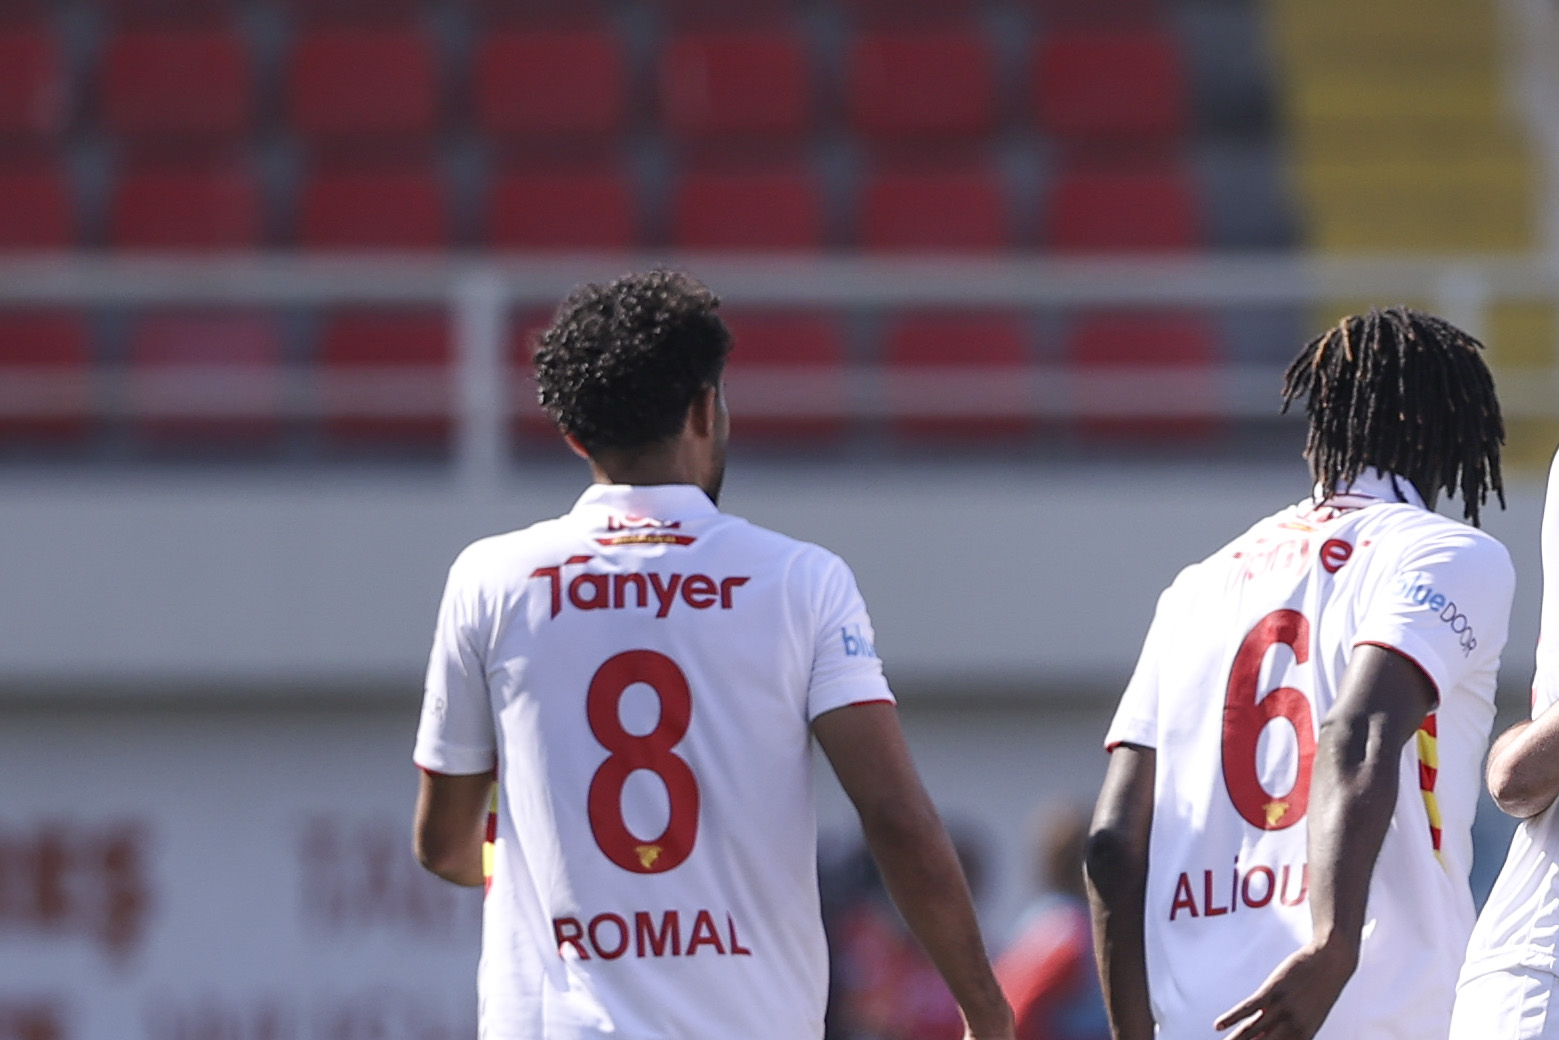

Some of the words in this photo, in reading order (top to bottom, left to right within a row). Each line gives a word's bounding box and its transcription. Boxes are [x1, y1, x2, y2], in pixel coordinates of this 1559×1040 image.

[528, 555, 751, 619] Tanyer
[586, 648, 699, 875] 8
[1221, 608, 1316, 831] 6
[553, 909, 752, 961] ROMAL
